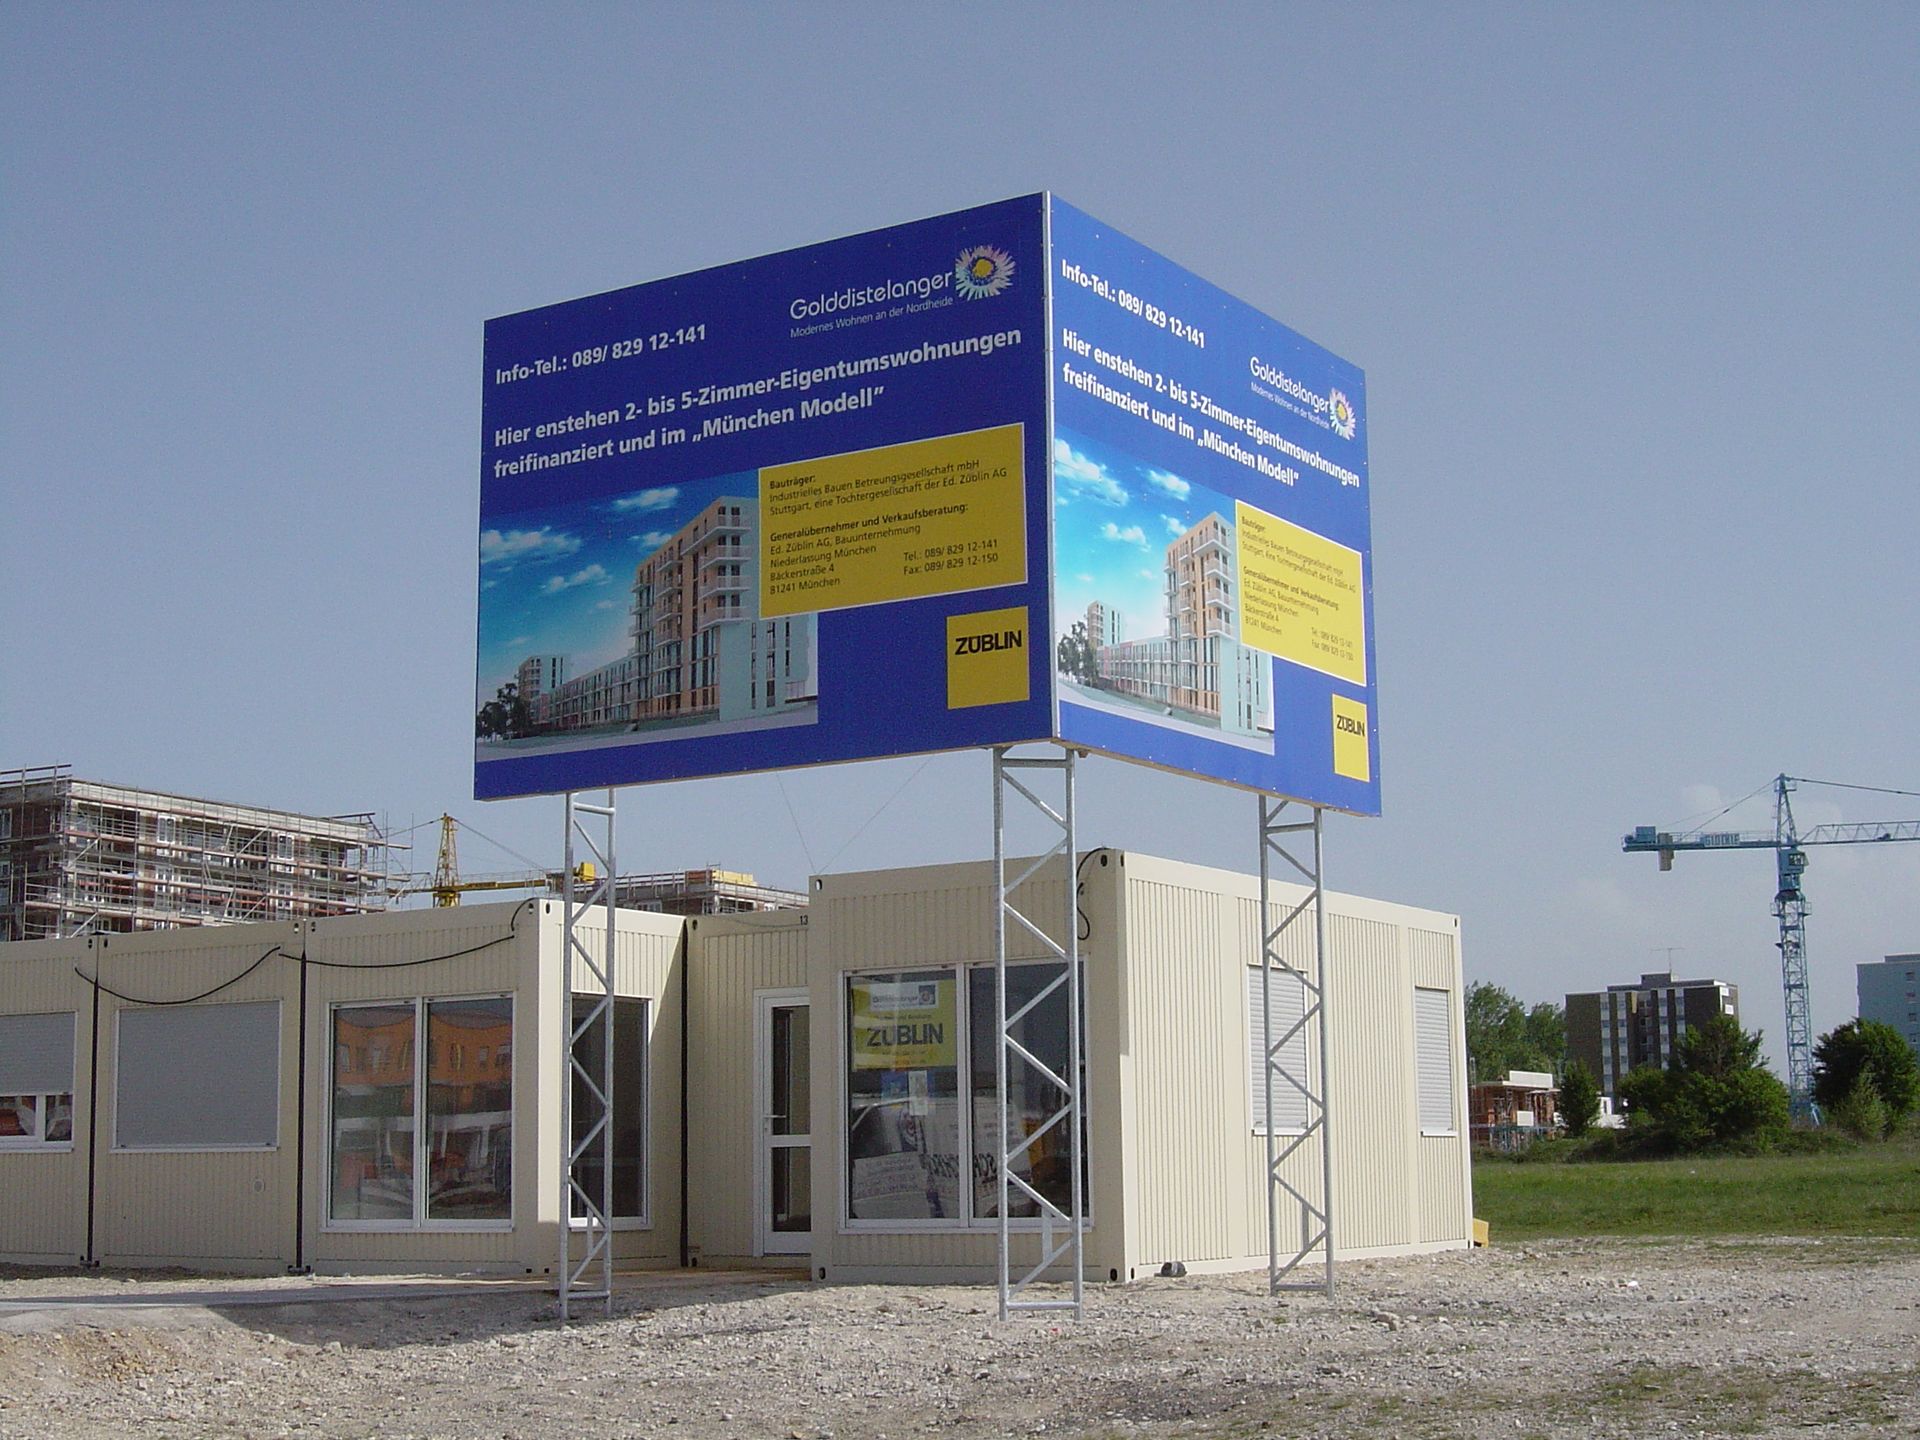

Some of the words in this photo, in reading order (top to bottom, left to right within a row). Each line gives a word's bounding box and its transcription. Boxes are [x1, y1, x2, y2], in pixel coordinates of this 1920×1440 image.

[790, 271, 953, 320] Golddistelanger
[790, 322, 834, 338] Modernes
[835, 313, 873, 329] Wohnen
[876, 311, 887, 320] an
[889, 305, 904, 317] der
[906, 295, 953, 314] Nordheide
[1062, 259, 1116, 302] Info-Tel.:
[1118, 289, 1143, 316] 089/
[1146, 303, 1166, 328] 829
[1169, 317, 1205, 348] 12-141
[496, 356, 567, 384] Info-Tel.:
[572, 345, 608, 368] 089/
[612, 338, 643, 359] 829
[649, 324, 706, 350] 12-141
[495, 427, 531, 447] Hier
[536, 411, 619, 438] enstehen
[625, 403, 642, 421] 2-
[648, 395, 675, 416] bis
[681, 329, 1021, 410] 5-Zimmer-Eigentumswohnungen
[1063, 362, 1149, 420] freifinanziert
[1152, 408, 1175, 431] und
[1179, 416, 1194, 440] im
[1250, 356, 1330, 414] Golddistelanger
[1063, 328, 1091, 357] Hier
[1094, 347, 1152, 388] enstehen
[1156, 374, 1167, 393] 2-
[1170, 379, 1187, 404] bis
[1190, 391, 1360, 488] 5-Zimmer-Eigentumswohnungen
[494, 440, 614, 478] freifinanziert
[619, 430, 655, 454] und
[662, 427, 685, 446] im
[769, 487, 822, 503] Industrielles
[825, 481, 852, 494] Bauen
[957, 459, 979, 471] mbH
[814, 498, 833, 509] eine
[924, 478, 939, 490] der
[992, 467, 1007, 478] AG
[770, 521, 859, 542] Generalübernehmer
[861, 516, 879, 527] und
[947, 544, 964, 555] 829
[967, 539, 998, 552] 12-141
[829, 564, 834, 572] 4
[946, 557, 964, 568] 829
[967, 553, 998, 565] 12-150
[770, 582, 796, 595] 81241
[799, 577, 840, 590] München
[955, 630, 1022, 655] ZÜBLIN
